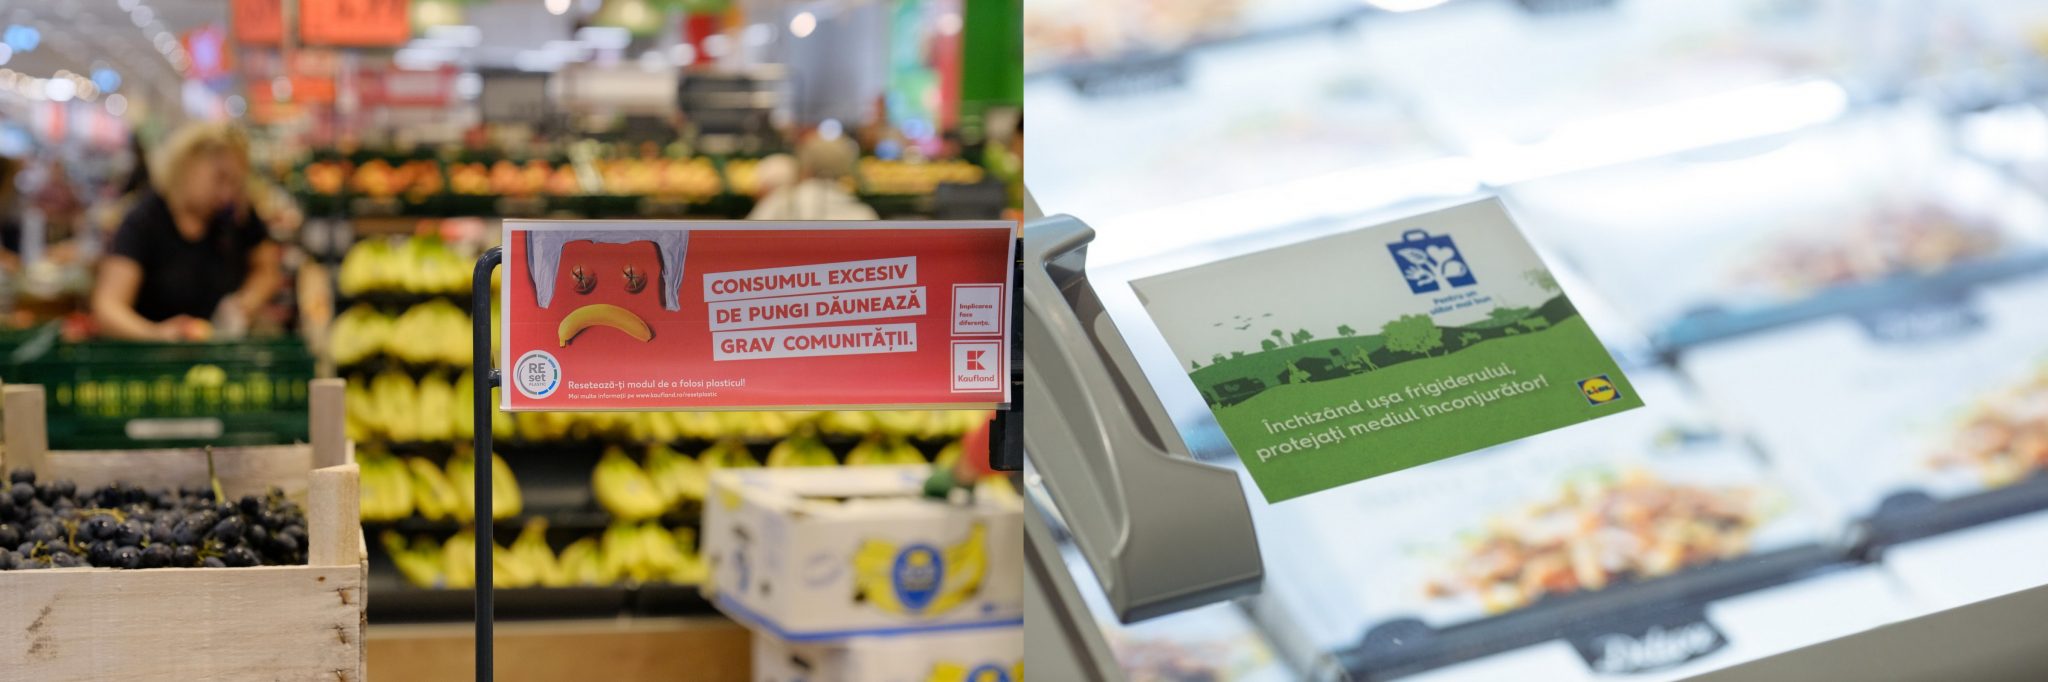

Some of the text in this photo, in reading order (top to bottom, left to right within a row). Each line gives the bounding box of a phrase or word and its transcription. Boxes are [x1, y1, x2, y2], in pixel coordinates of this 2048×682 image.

[711, 264, 909, 295] CONSUMUL EXCESIV
[716, 289, 921, 324] DE PUNGI DĂUNEAZĂ
[959, 303, 993, 311] Implicarea
[721, 327, 914, 354] GRAV COMUNITĂȚII.
[528, 363, 546, 374] RE
[528, 373, 546, 382] set
[627, 380, 656, 389] modul
[657, 379, 669, 388] de
[680, 378, 704, 388] folosi
[706, 378, 746, 389] plasticul!
[958, 374, 995, 383] Kaufland
[1262, 362, 1517, 435] Închizând ușa frigiderului,
[1256, 374, 1550, 463] protejați mediul înconjurător!
